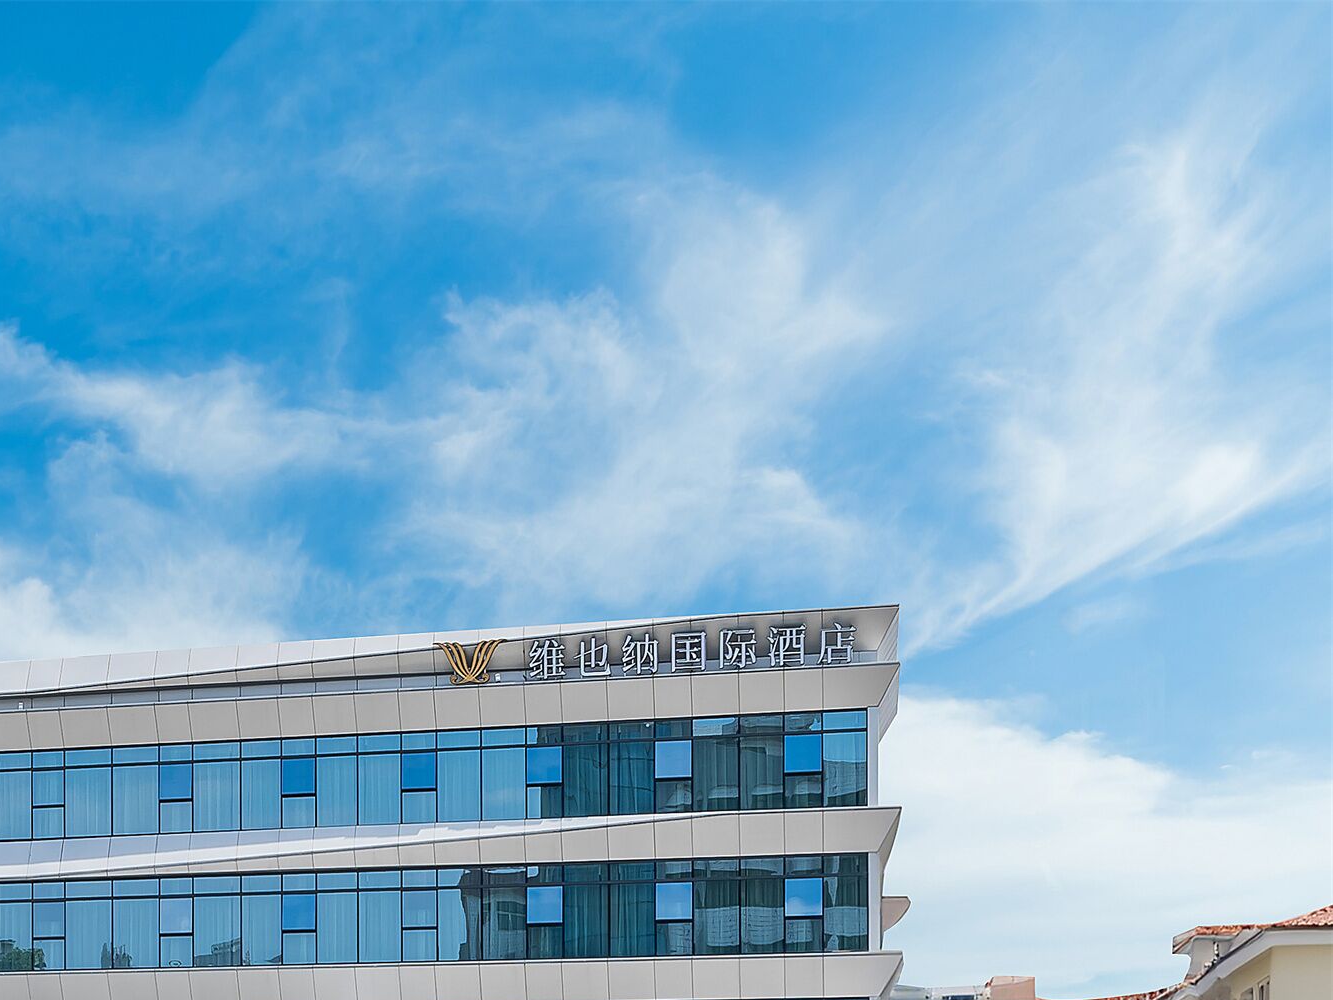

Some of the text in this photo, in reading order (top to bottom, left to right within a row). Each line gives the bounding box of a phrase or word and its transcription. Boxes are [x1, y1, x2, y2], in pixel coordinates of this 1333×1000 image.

[528, 623, 858, 680] 维也纳国际酒店
